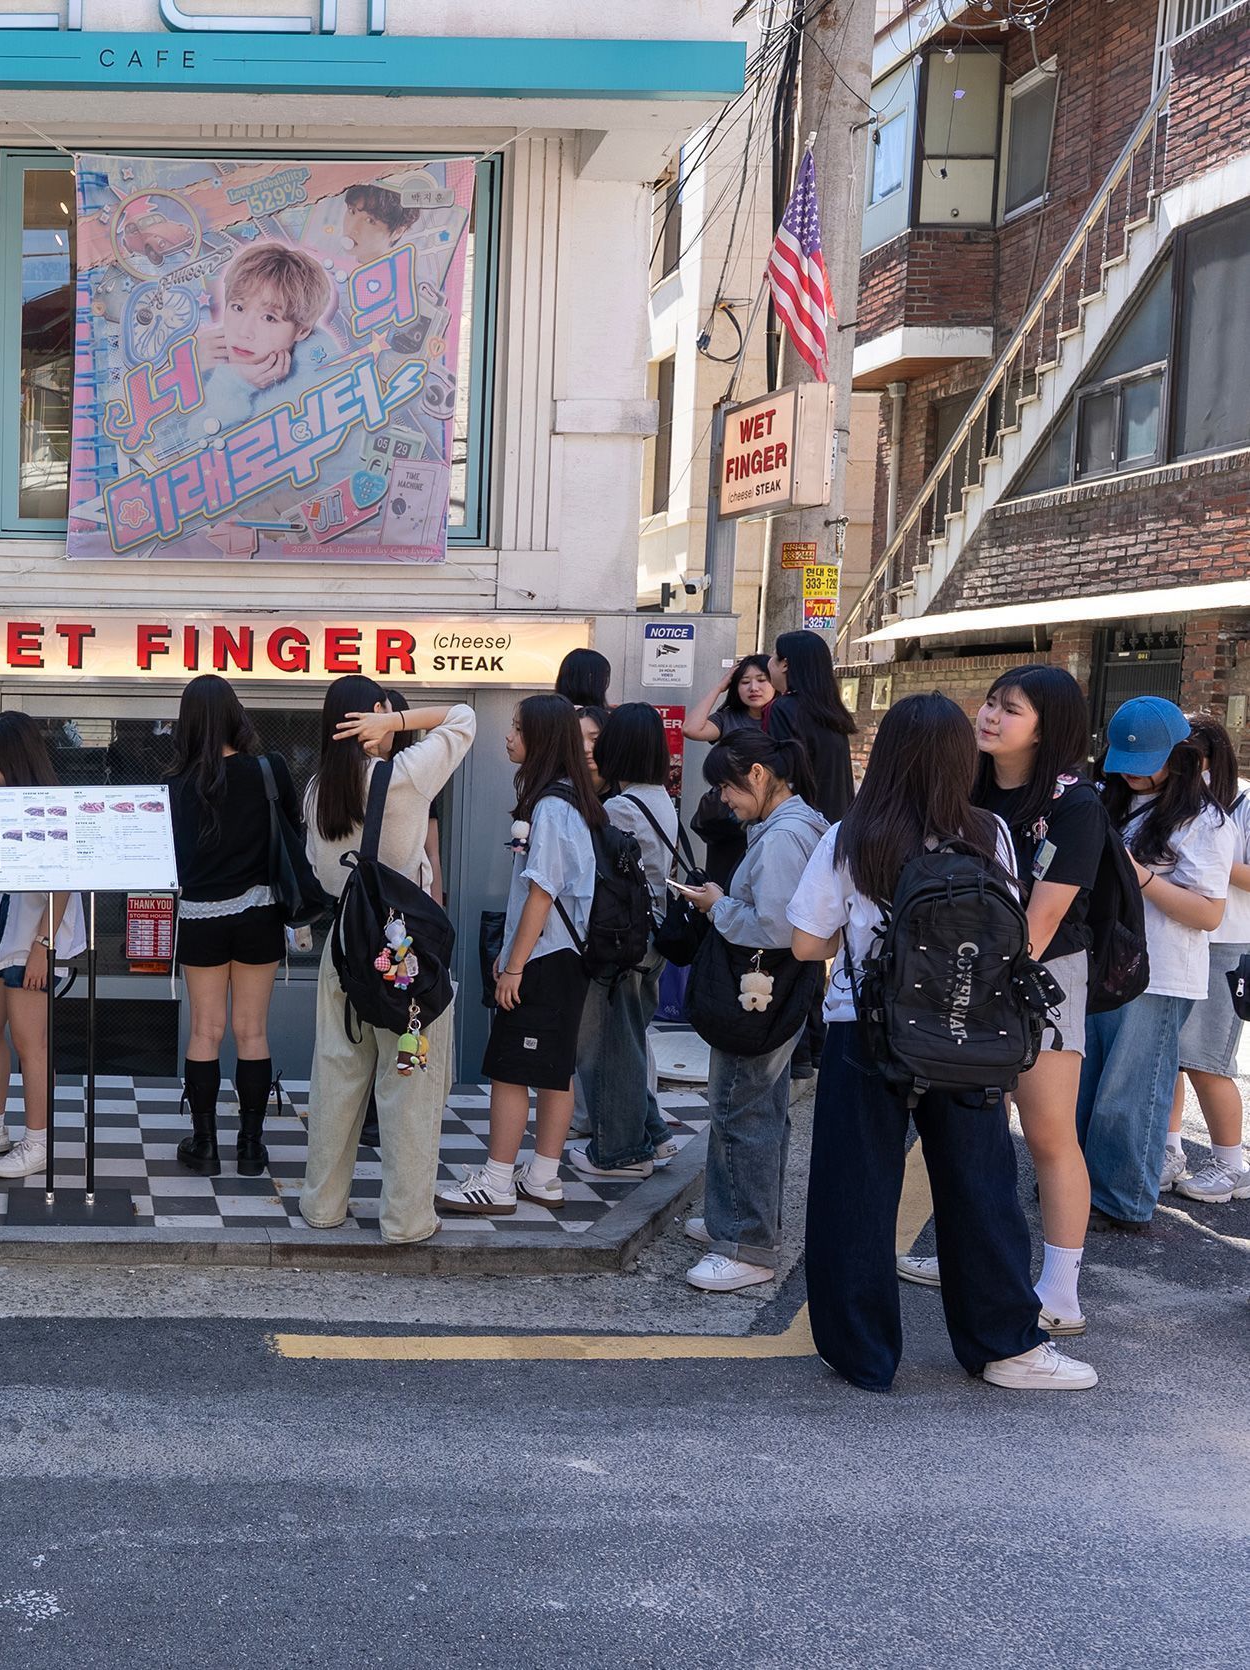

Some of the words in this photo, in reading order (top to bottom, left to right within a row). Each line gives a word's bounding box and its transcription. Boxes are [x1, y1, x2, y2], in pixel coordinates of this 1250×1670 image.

[99, 49, 196, 68] CAFE
[250, 182, 305, 214] 529%
[739, 409, 777, 444] WET
[377, 437, 388, 449] 05
[395, 442, 408, 456] 29
[725, 442, 788, 483] FINGER
[405, 471, 421, 481] TIME
[755, 479, 781, 497] STEAK
[806, 568, 825, 577] 현대
[650, 627, 689, 638] NOTICE
[137, 625, 418, 675] FINGER
[433, 632, 512, 651] (cheese)
[433, 656, 505, 673] STEAK
[130, 899, 156, 910] THANK
[156, 899, 172, 910] YOU
